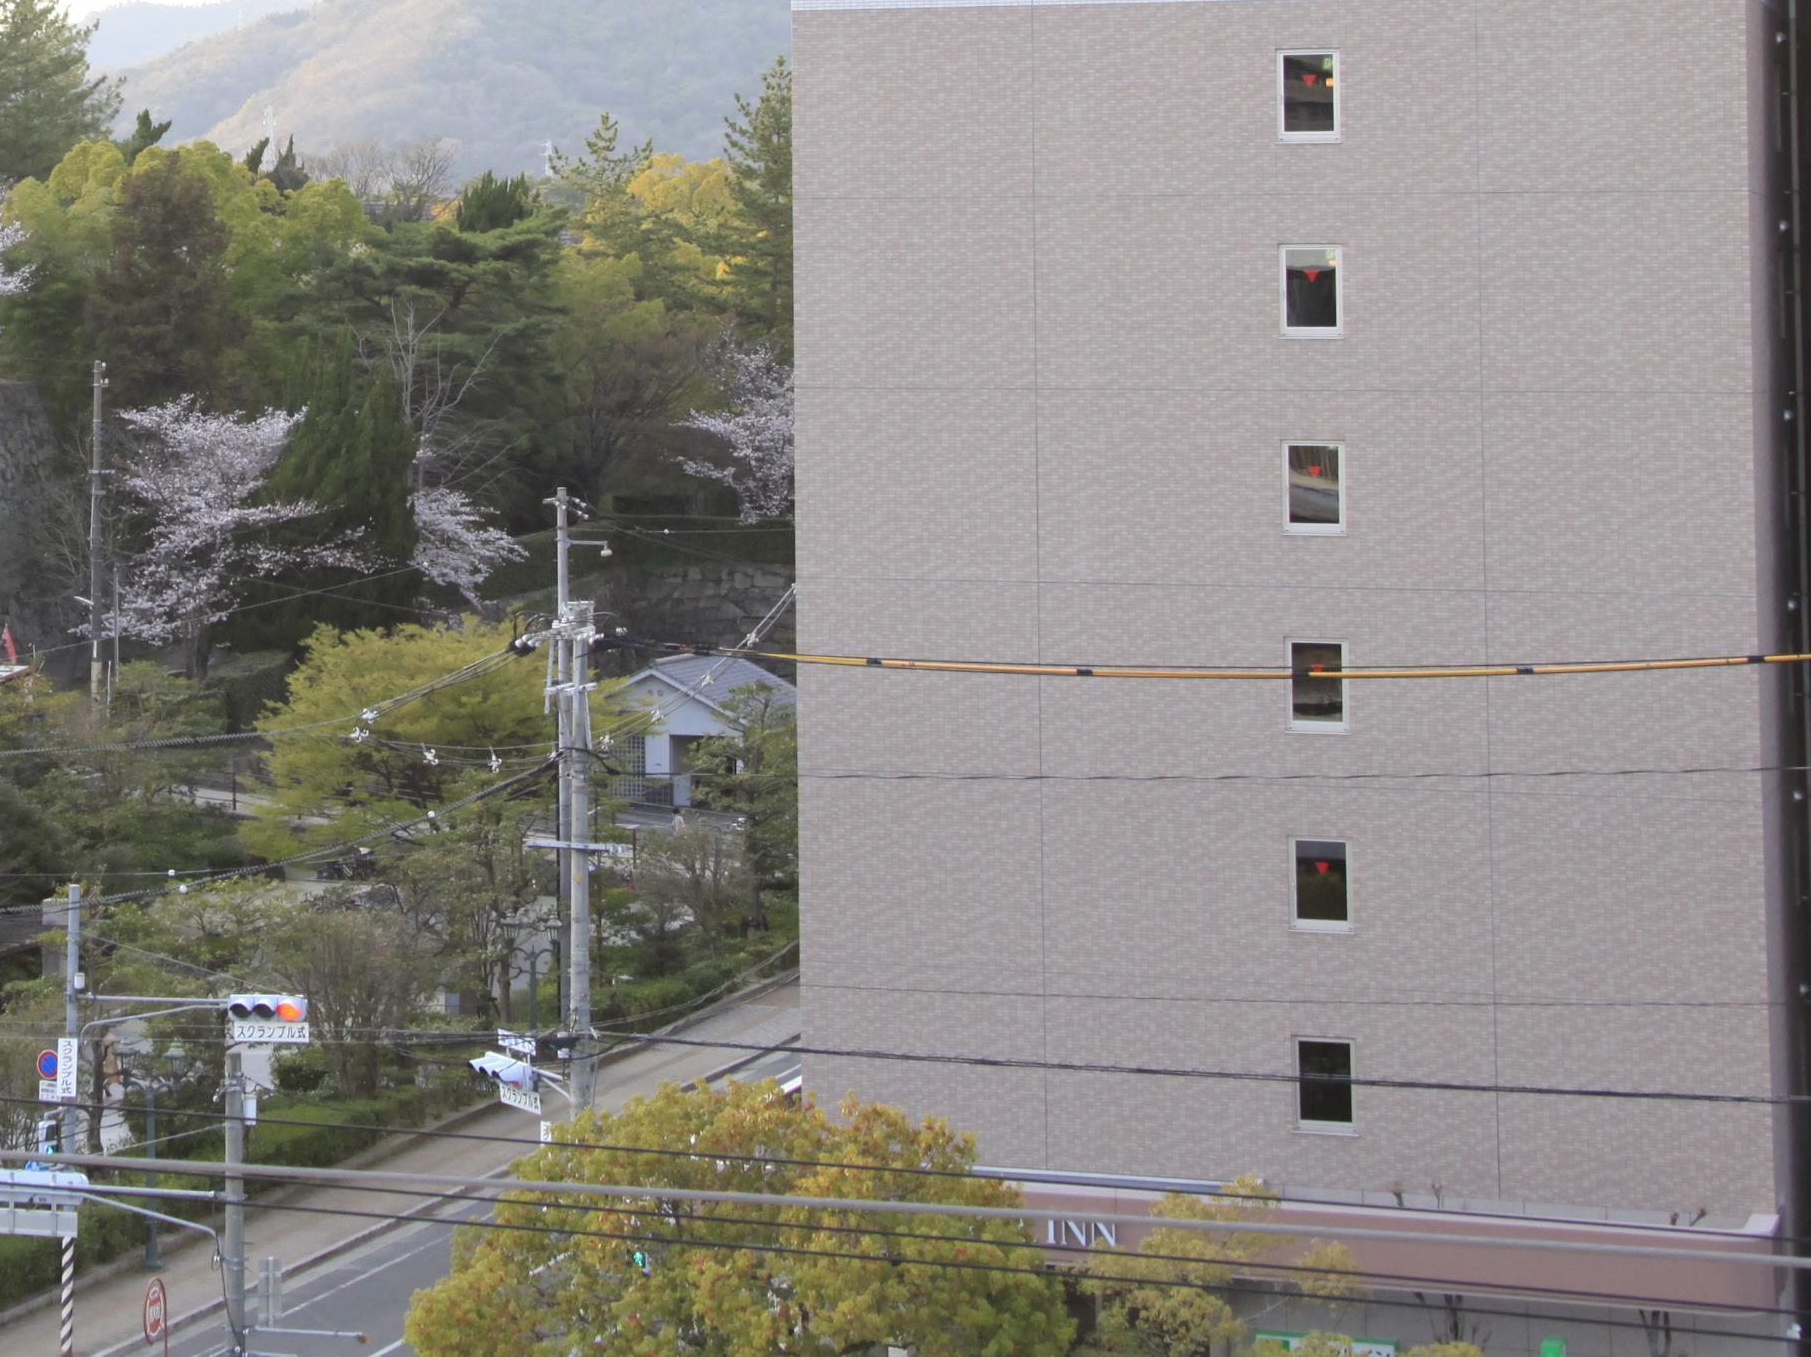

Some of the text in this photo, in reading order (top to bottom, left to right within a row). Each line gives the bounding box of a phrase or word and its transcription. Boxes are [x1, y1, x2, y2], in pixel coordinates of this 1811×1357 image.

[237, 1025, 306, 1039] スクランブル式
[1046, 1217, 1117, 1247] INN
